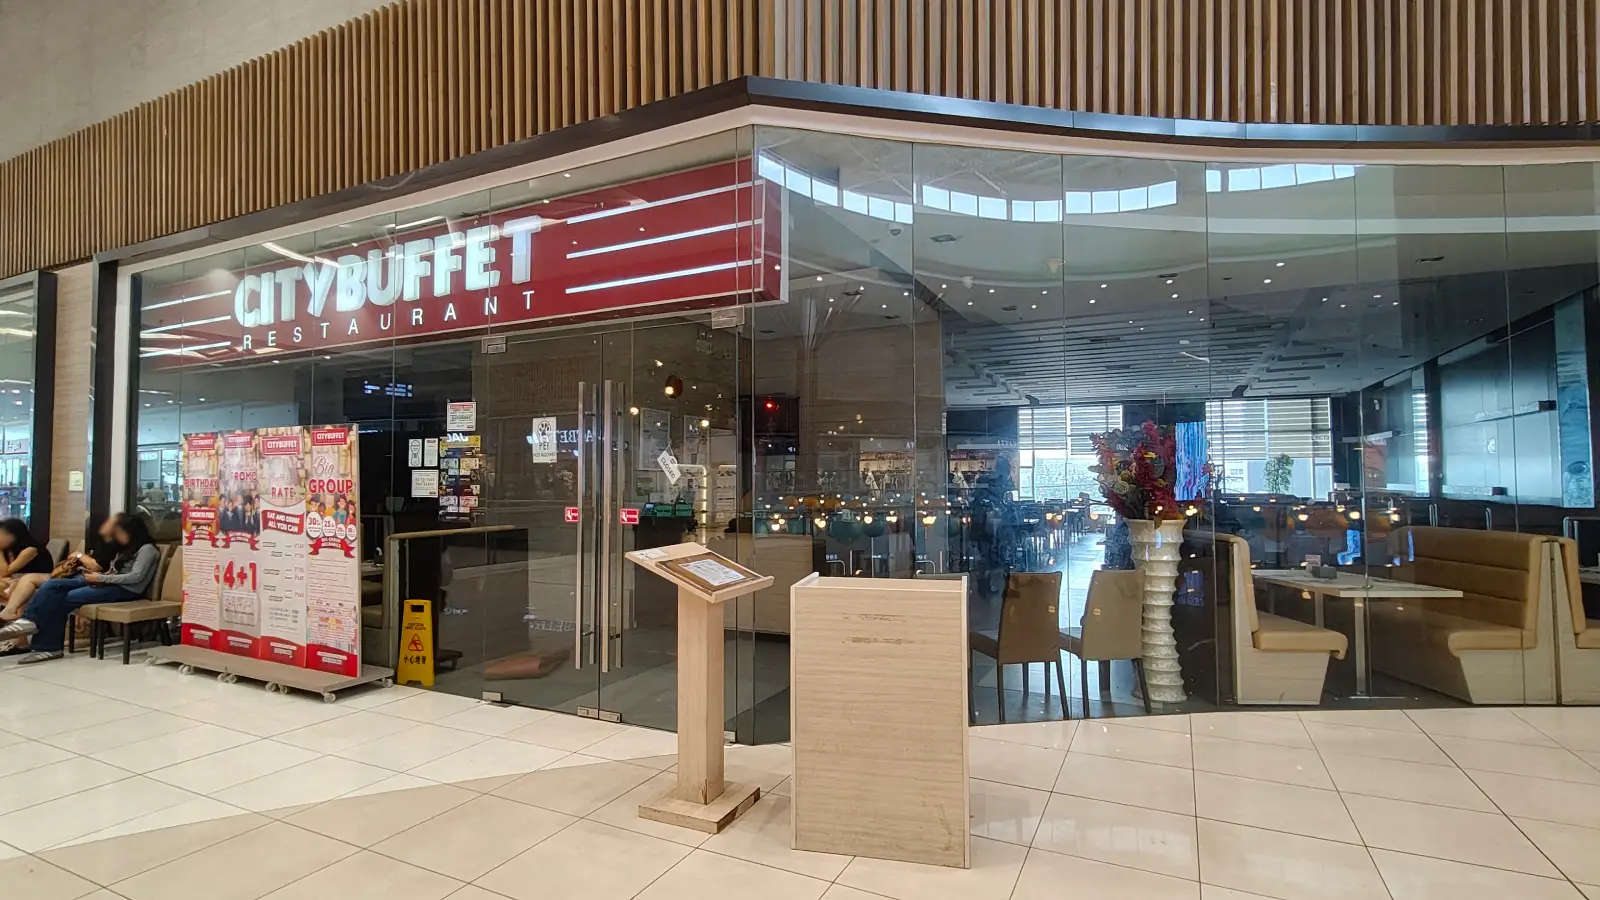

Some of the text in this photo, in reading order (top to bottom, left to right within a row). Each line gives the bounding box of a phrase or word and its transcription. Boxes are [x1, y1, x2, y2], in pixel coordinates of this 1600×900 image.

[234, 215, 542, 328] CITYBUFFET
[243, 290, 535, 350] RESTAURANT
[316, 432, 345, 440] CITYBUFFET
[266, 440, 297, 449] CITYBUFFET
[539, 442, 550, 451] PET
[313, 456, 335, 478] Big
[660, 457, 676, 479] CLOSED
[184, 479, 218, 488] BIRTHDAY
[308, 478, 353, 494] GROUP
[271, 486, 294, 498] RATE
[268, 520, 277, 528] ALL
[277, 523, 287, 531] YOU
